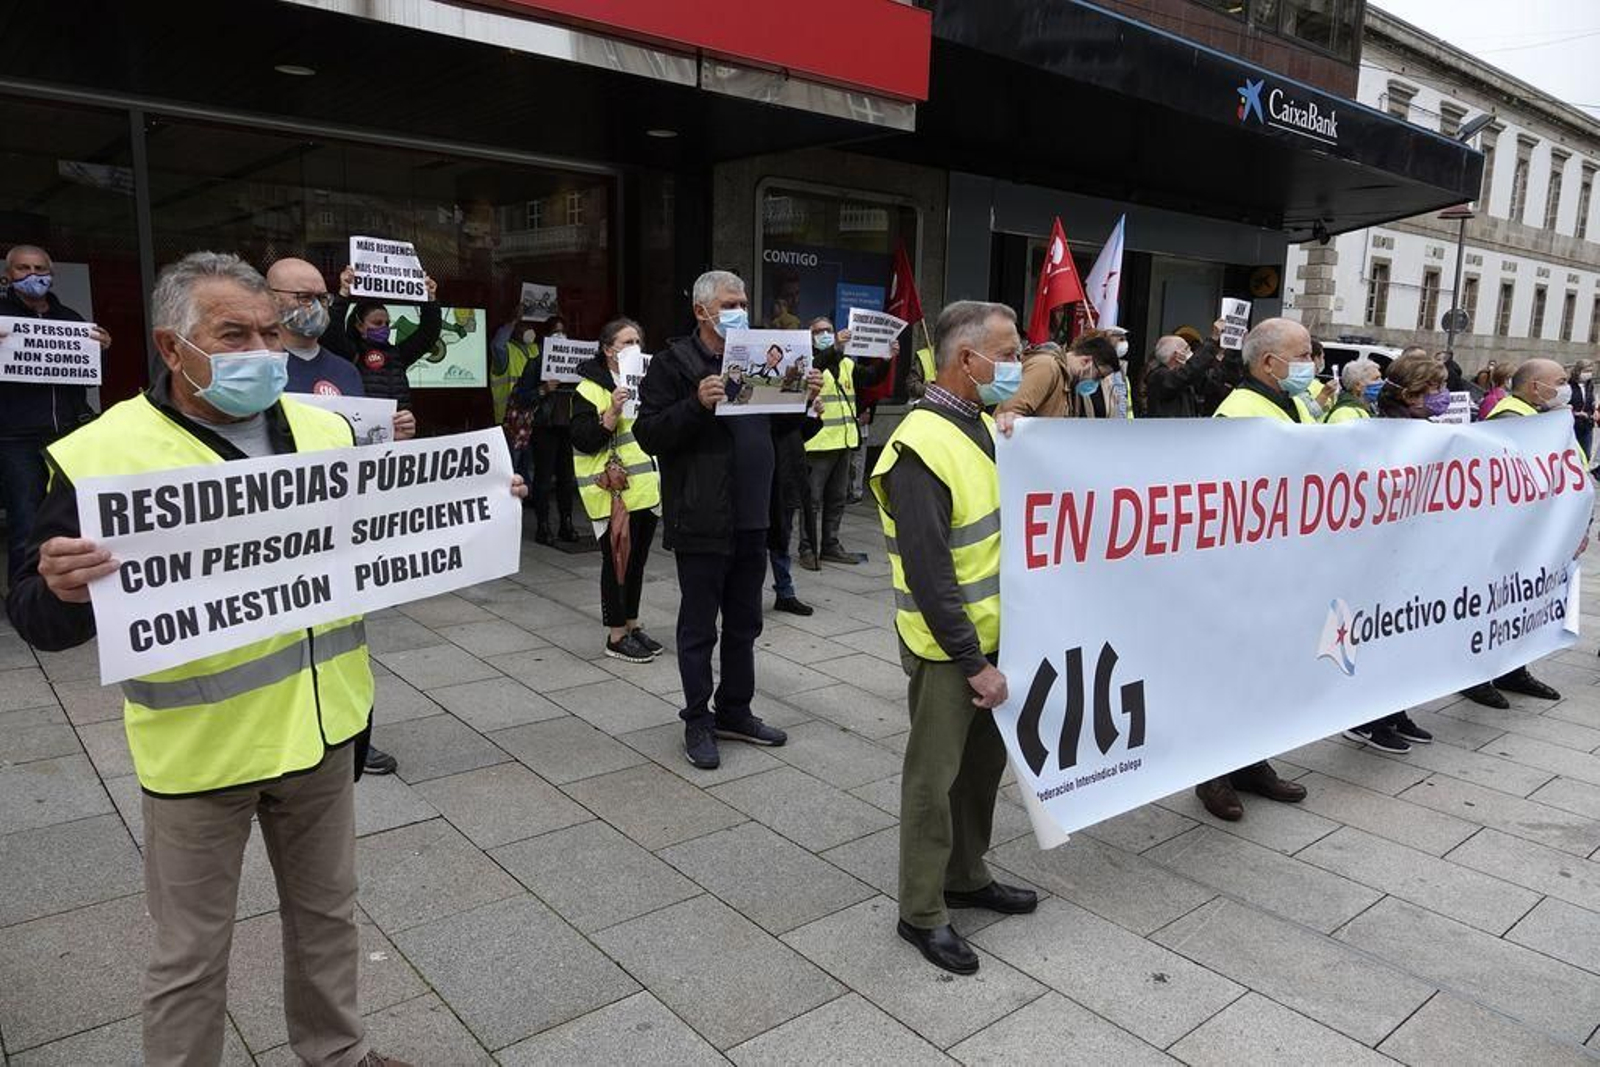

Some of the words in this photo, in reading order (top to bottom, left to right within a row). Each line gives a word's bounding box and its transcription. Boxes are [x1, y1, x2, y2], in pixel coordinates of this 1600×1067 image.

[1269, 88, 1338, 138] CaixaBank
[763, 249, 818, 267] CONTIGO
[353, 275, 424, 296] PÚBLICOS
[13, 323, 30, 334] AS
[33, 324, 89, 338] PERSOAS
[13, 351, 42, 363] NON
[44, 352, 90, 364] SOMOS
[24, 338, 81, 351] MAIORES
[4, 364, 98, 379] MERCADORÍAS
[98, 461, 348, 538] RESIDENCIAS
[357, 443, 490, 495] PÚBLICAS
[1025, 490, 1095, 570] EN
[1105, 477, 1288, 560] DEFENSA
[1299, 470, 1368, 535] DOS
[1372, 458, 1483, 526] SERVIZOS
[119, 552, 192, 594] CON
[202, 526, 335, 577] PERSOAL
[351, 496, 491, 545] SUFICIENTE
[129, 607, 200, 652] CON
[204, 574, 332, 632] XESTIÓN
[354, 545, 463, 591] PÚBLICA
[1350, 595, 1446, 646] Colectivo
[1453, 586, 1482, 620] de
[1471, 630, 1483, 654] e
[1075, 764, 1118, 788] Intersindical
[1119, 758, 1142, 774] Galega
